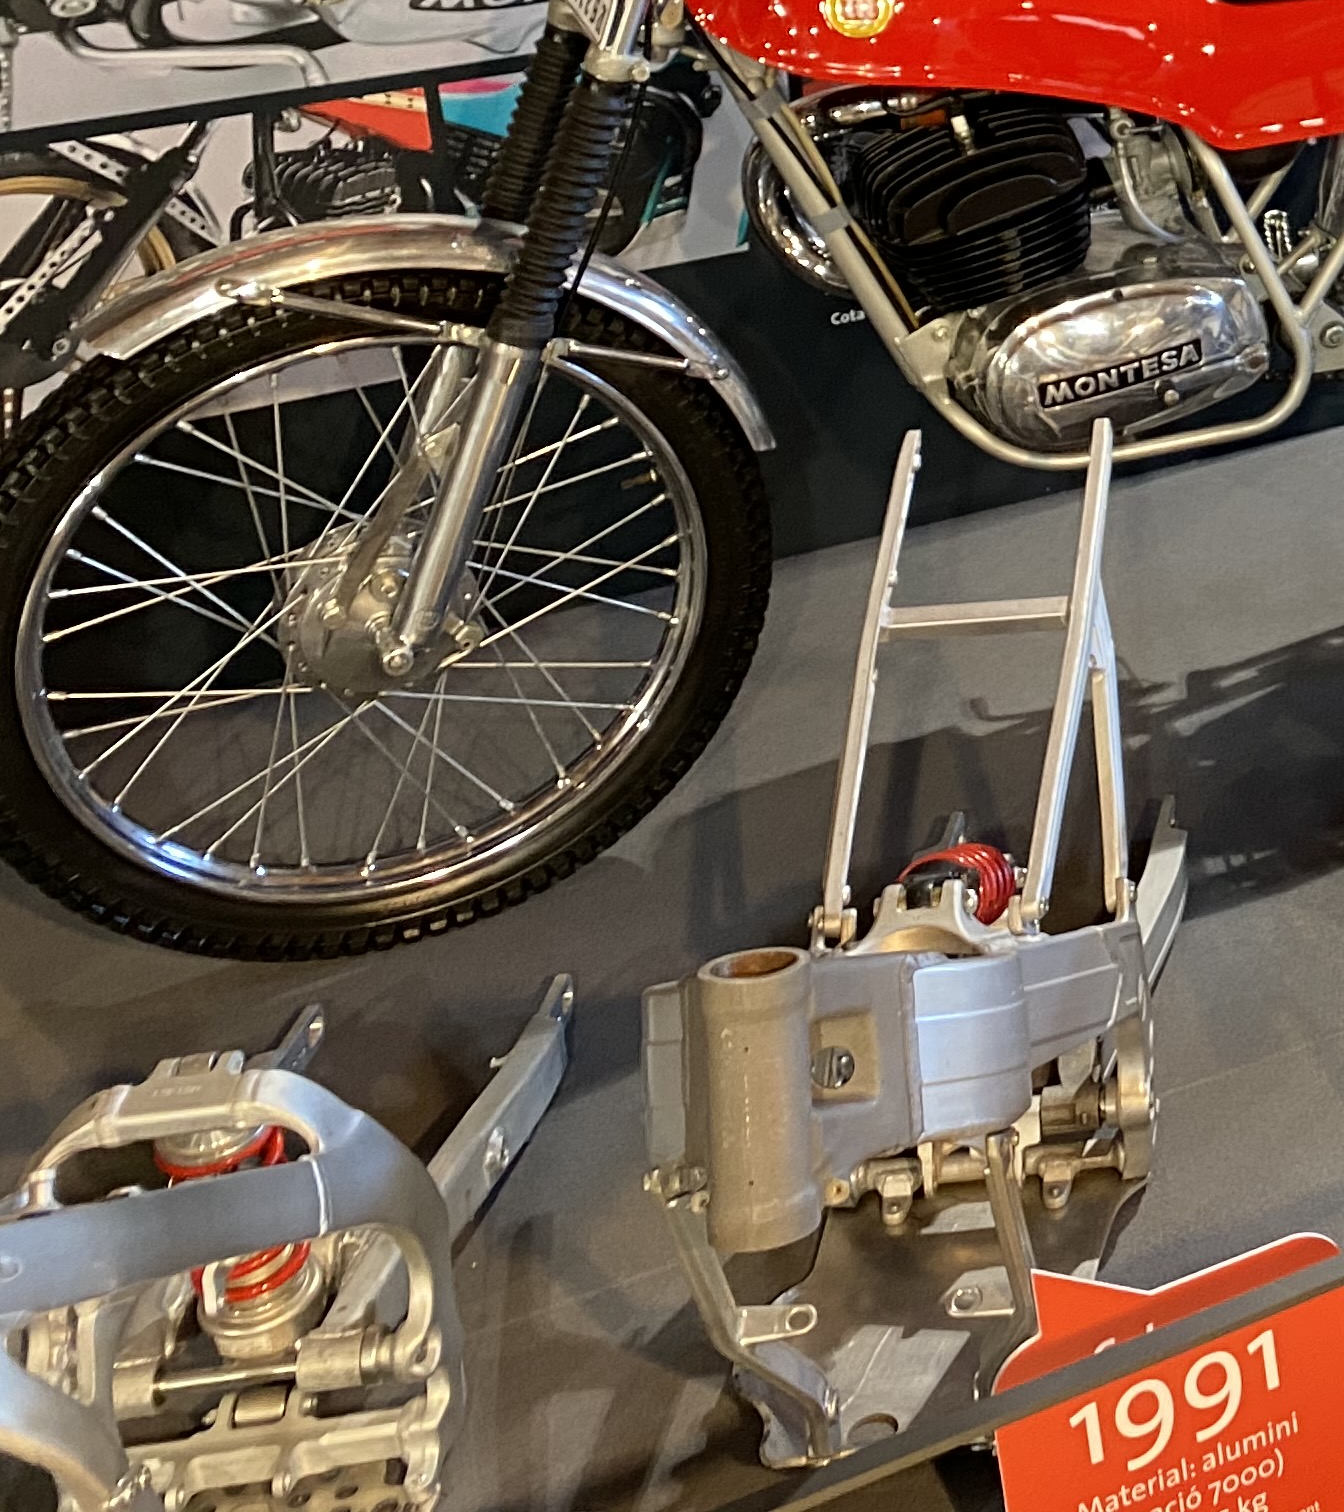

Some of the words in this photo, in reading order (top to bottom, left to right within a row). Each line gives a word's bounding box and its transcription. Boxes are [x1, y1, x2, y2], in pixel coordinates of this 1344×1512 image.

[1043, 343, 1200, 406] MONTESA
[1068, 1328, 1282, 1472] 1991
[1077, 1457, 1197, 1512] Material:
[1202, 1411, 1300, 1474] alumini
[1206, 1447, 1284, 1506] 7000)
